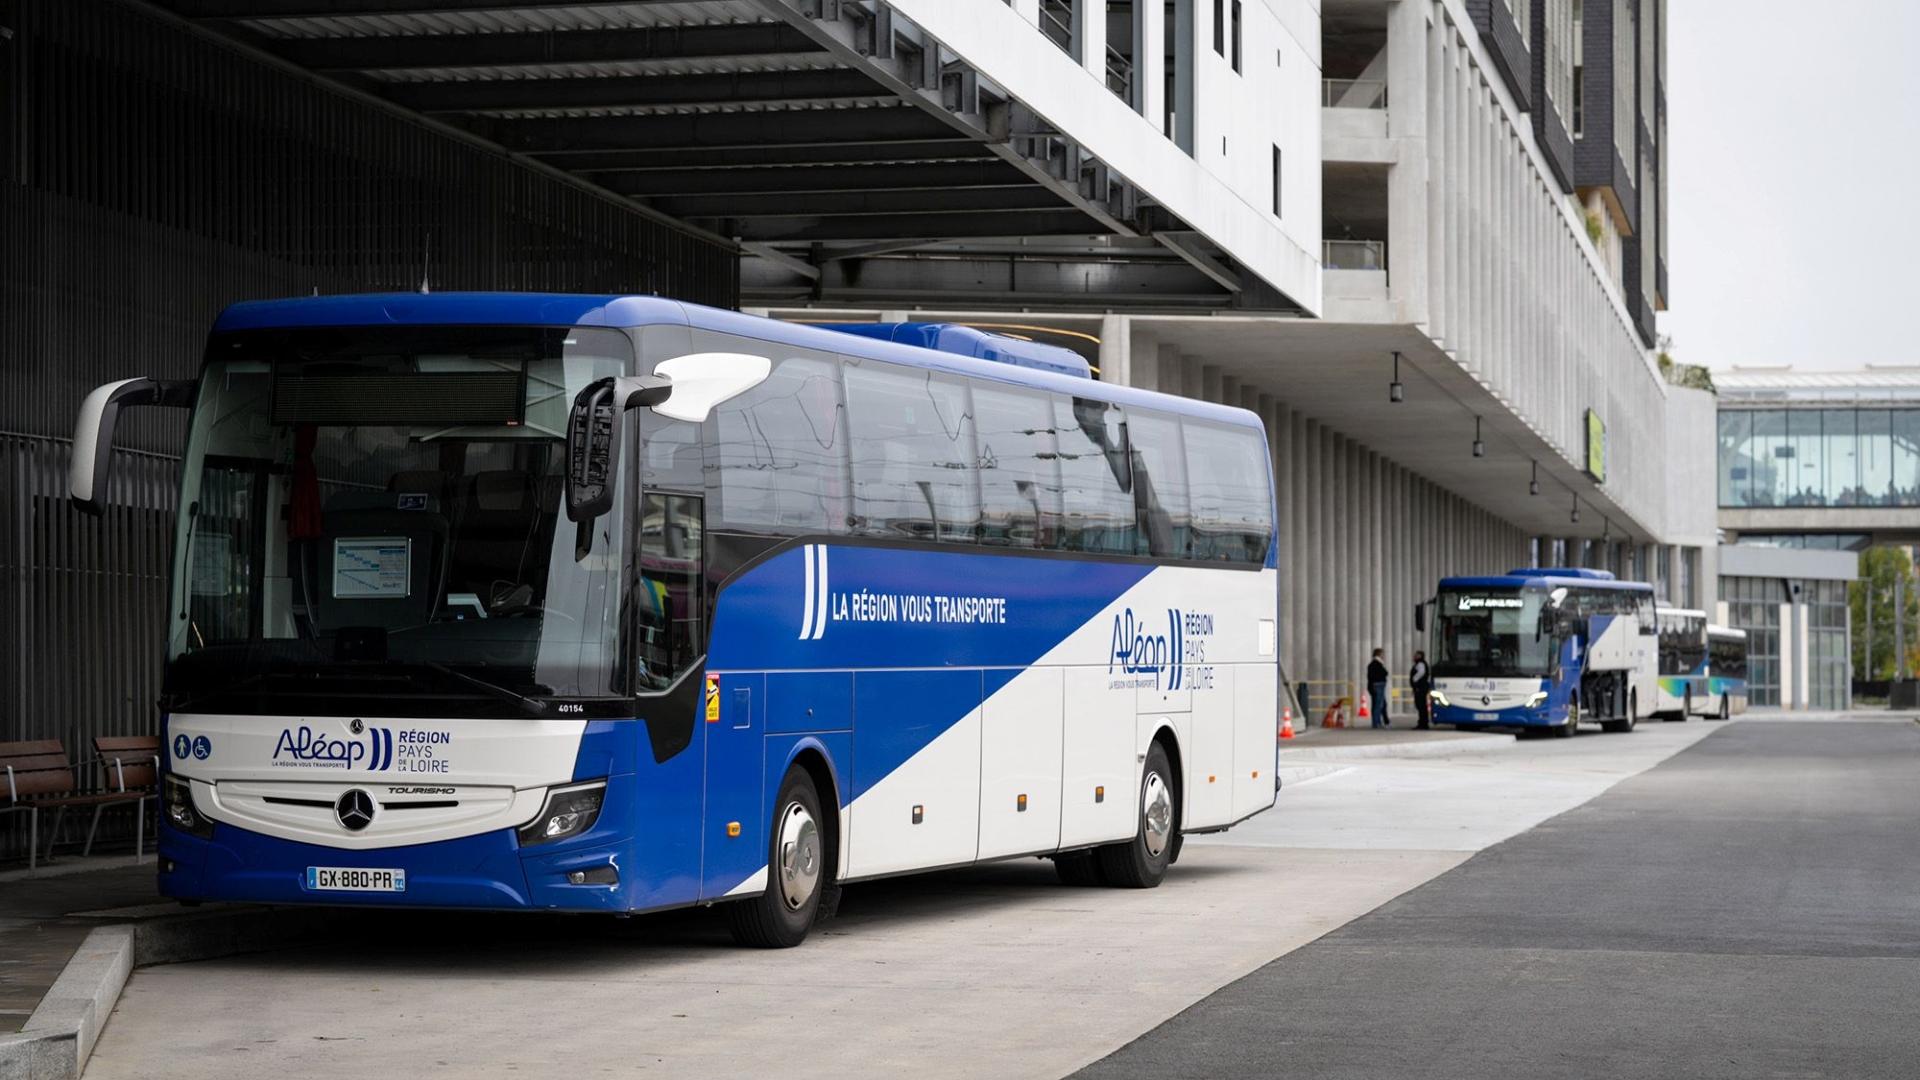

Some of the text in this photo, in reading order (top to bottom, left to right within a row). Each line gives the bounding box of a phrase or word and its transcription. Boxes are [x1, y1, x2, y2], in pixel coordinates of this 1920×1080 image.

[833, 588, 1006, 623] LA RÉGION VOUS TRANSPORTE
[1185, 609, 1213, 635] RÉGION
[1109, 608, 1167, 691] Aléop
[1185, 640, 1205, 663] PAYS
[1192, 666, 1213, 690] LOIRE
[558, 704, 584, 713] 40154
[399, 728, 450, 744] RÉGION
[273, 726, 365, 770] Aléop
[398, 744, 433, 759] PAYS
[410, 759, 449, 773] LOIRE
[388, 787, 456, 795] TOURISMO
[319, 870, 392, 889] GX-880-PR
